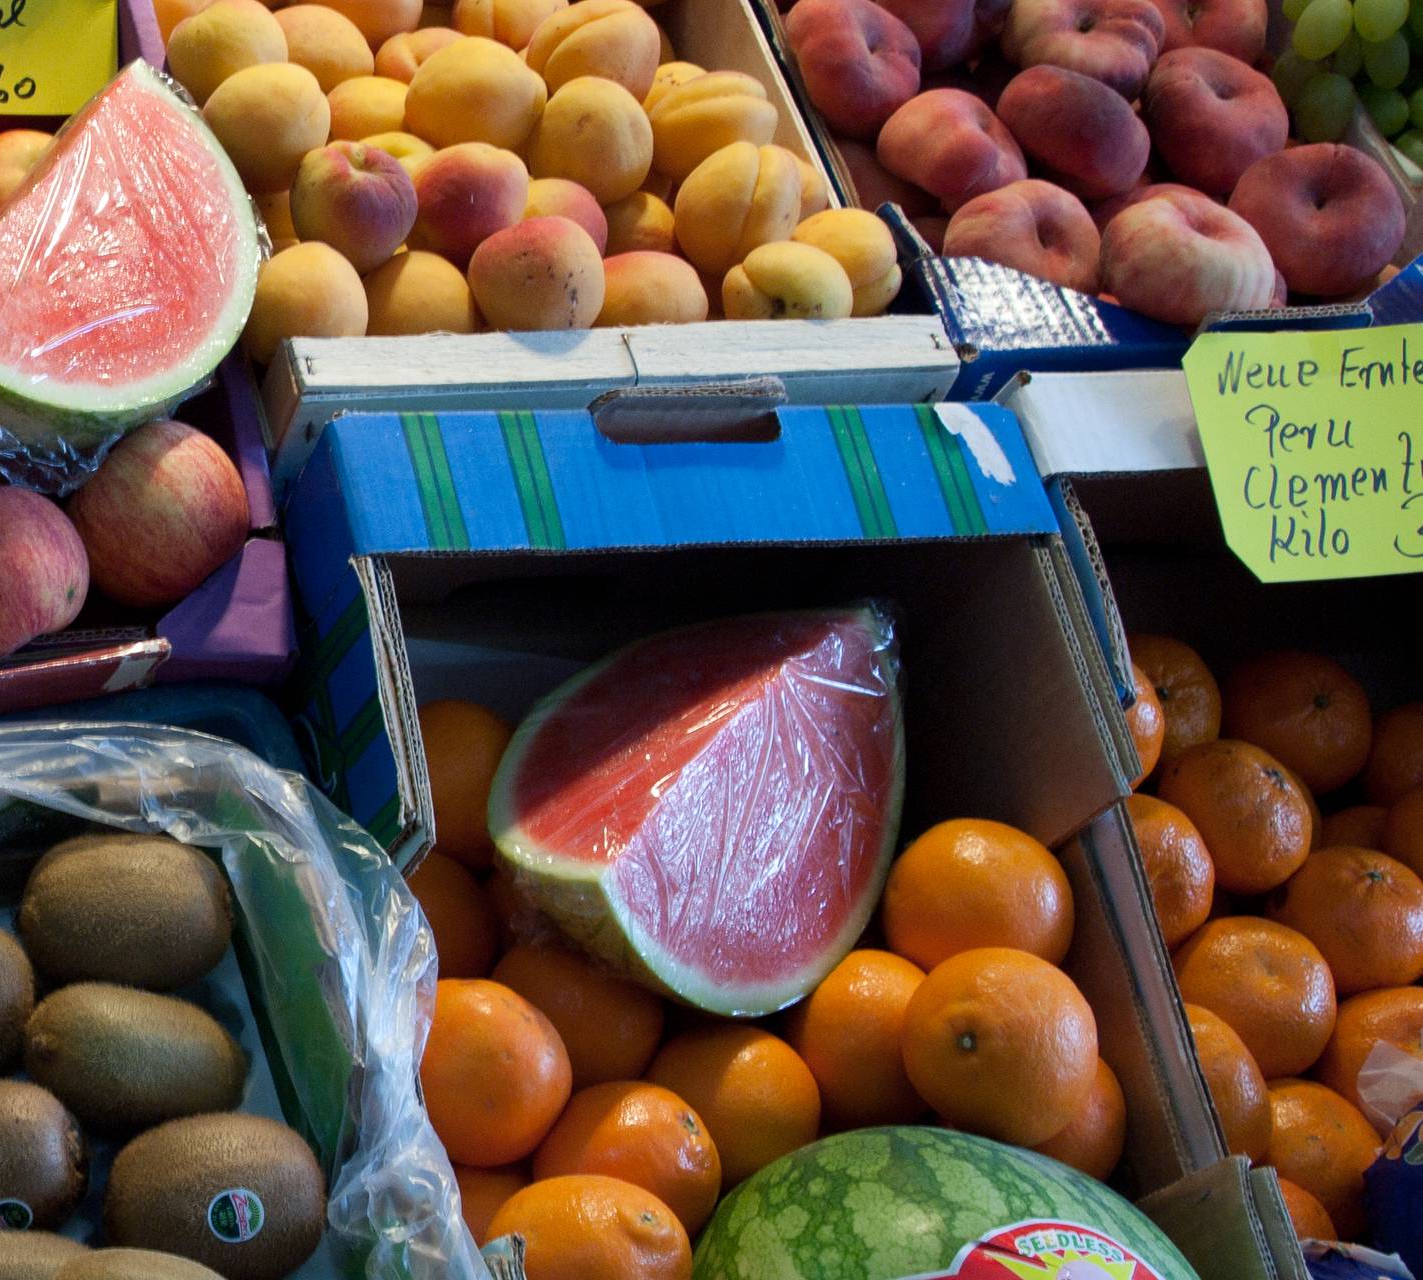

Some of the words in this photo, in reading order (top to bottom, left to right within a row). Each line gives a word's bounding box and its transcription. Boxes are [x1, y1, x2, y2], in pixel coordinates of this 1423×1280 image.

[1218, 351, 1319, 396] Neue
[1245, 404, 1354, 458] Peru
[1244, 431, 1423, 510] Clement
[1017, 1232, 1123, 1263] SEEDLESS
